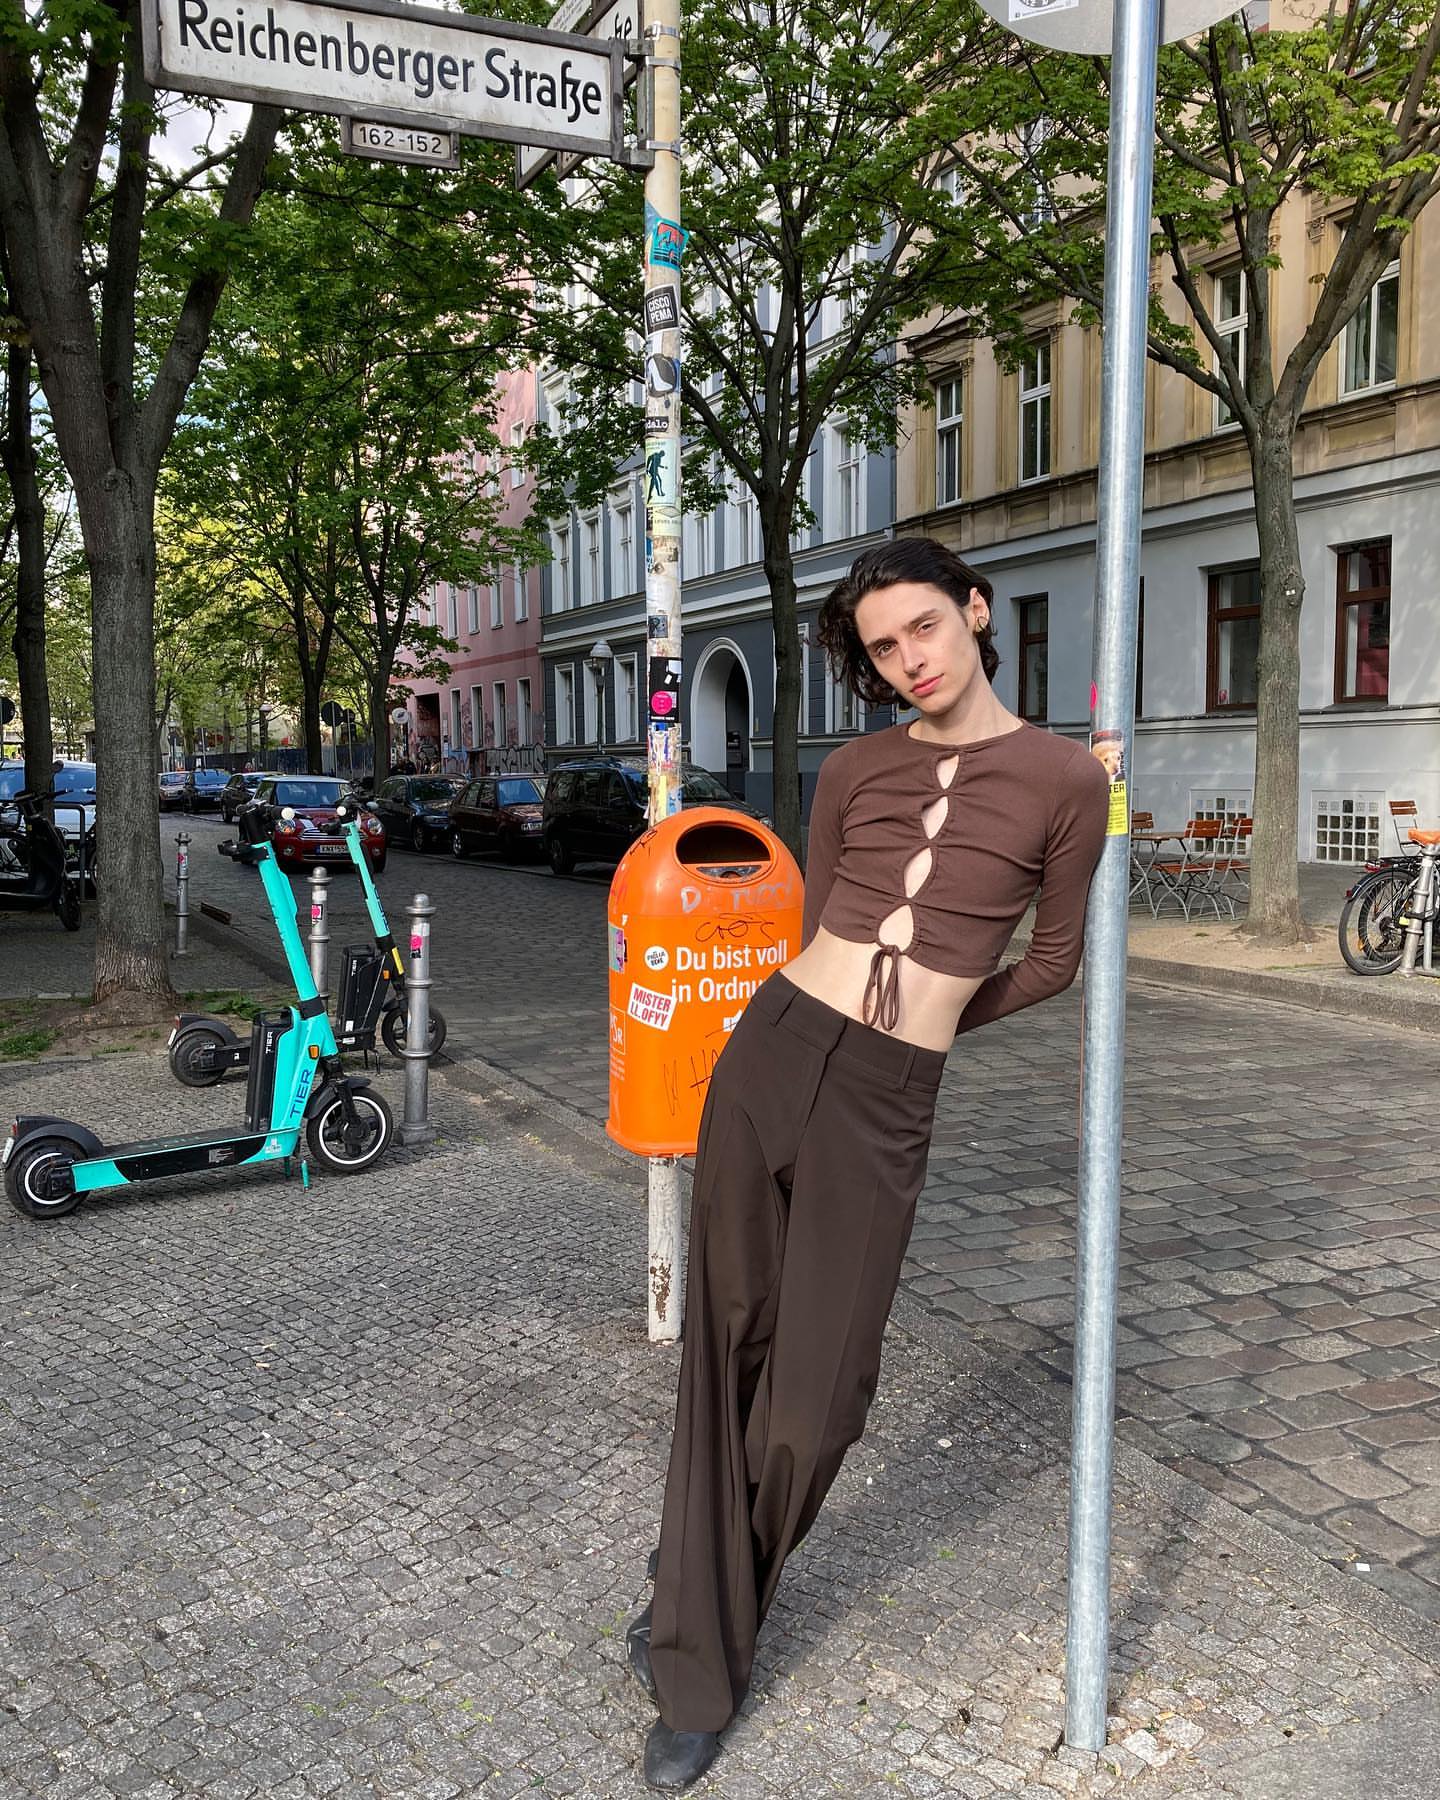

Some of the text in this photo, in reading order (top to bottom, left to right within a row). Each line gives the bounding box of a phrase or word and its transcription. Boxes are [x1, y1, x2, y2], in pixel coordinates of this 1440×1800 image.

[178, 0, 602, 123] Reichenberger Straße
[359, 127, 442, 154] 162-152
[648, 295, 669, 312] CISCO
[650, 309, 672, 323] PEMA
[677, 939, 788, 971] Du bist voll
[633, 988, 671, 1012] MISTER
[672, 979, 692, 1002] in
[265, 1031, 273, 1054] TIER
[290, 1069, 312, 1118] TIER
